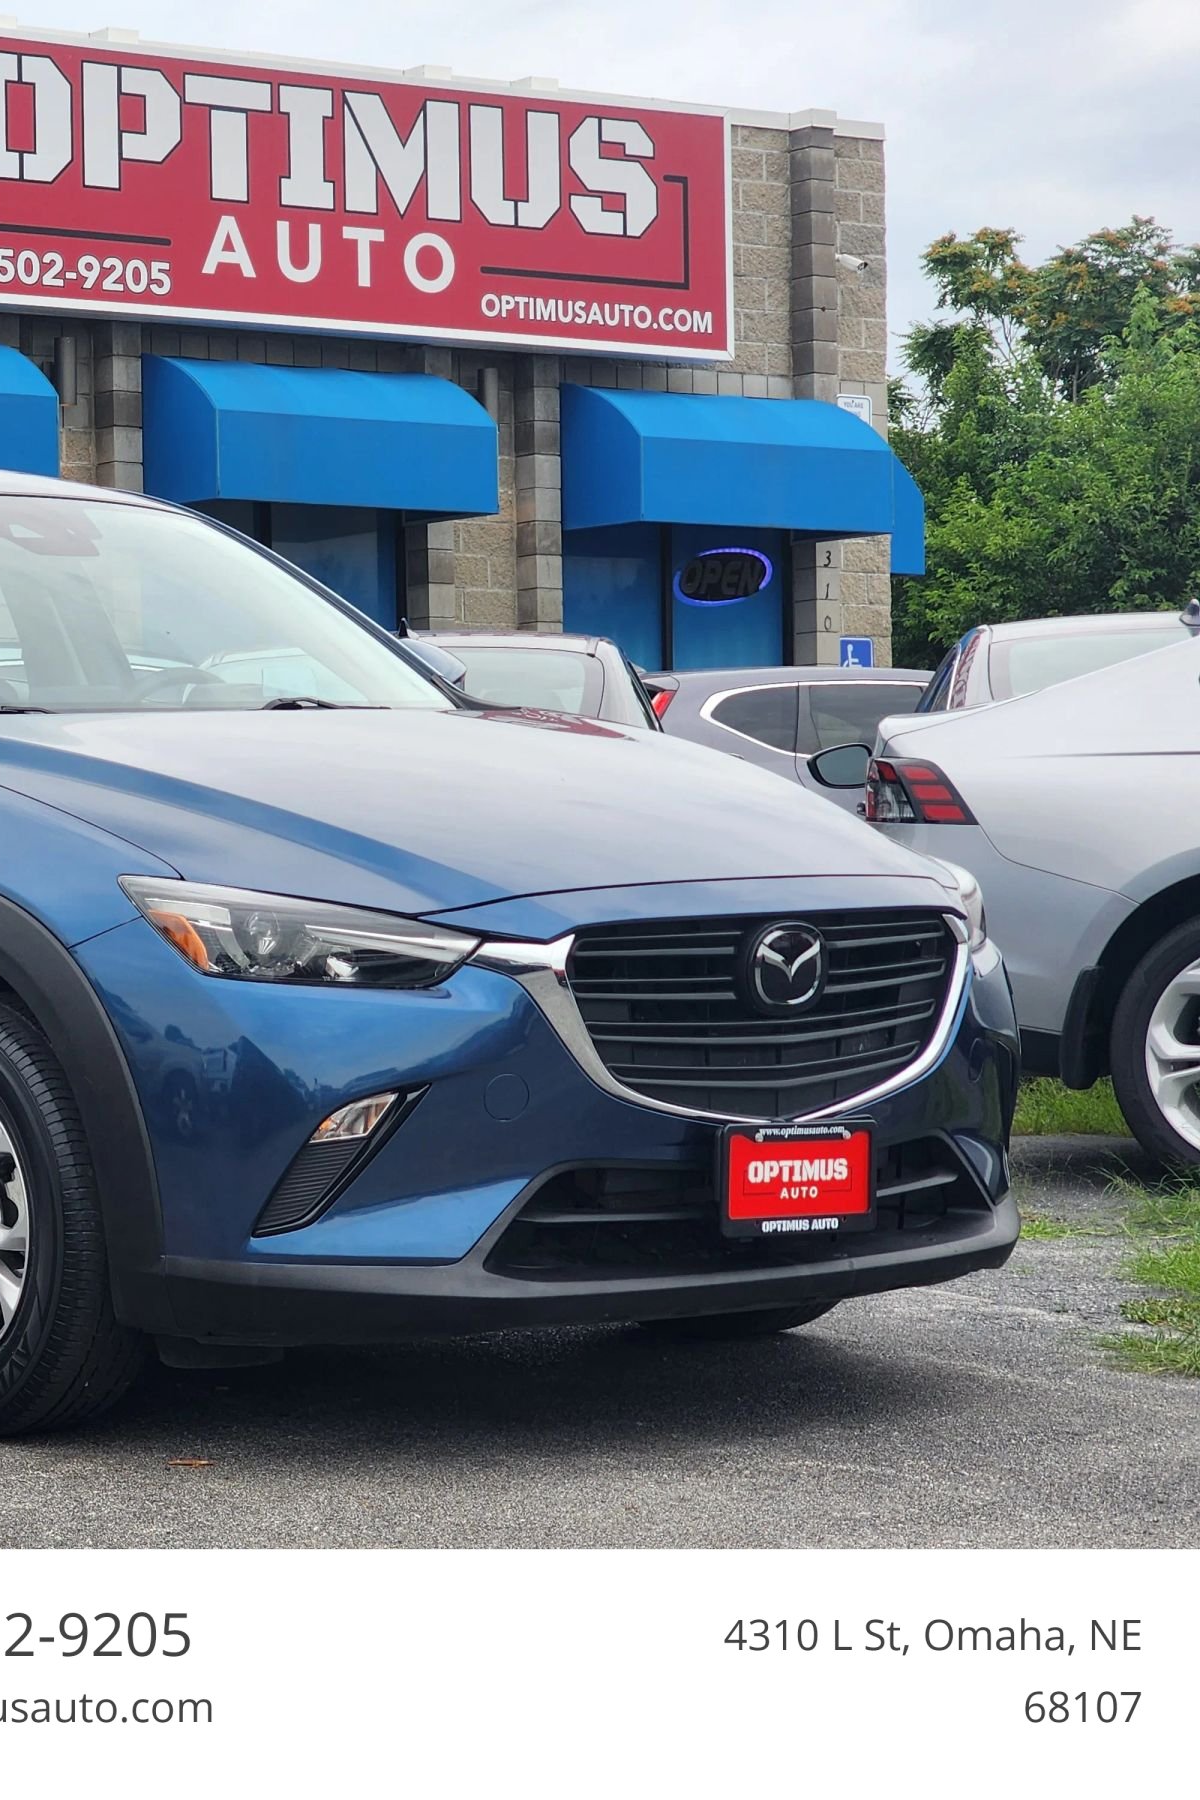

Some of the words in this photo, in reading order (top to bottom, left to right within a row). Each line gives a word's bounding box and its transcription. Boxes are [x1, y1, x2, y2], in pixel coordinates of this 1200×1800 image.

[202, 215, 456, 293] AUTO
[481, 293, 712, 333] OPTIMUSAUTO.COM
[683, 558, 763, 594] OPEN
[759, 1126, 845, 1139] www.optimusauto.com
[748, 1158, 848, 1183] OPTIMUS
[780, 1186, 819, 1199] AUTO
[762, 1219, 809, 1233] OPTIMUS
[811, 1217, 839, 1231] AUTO
